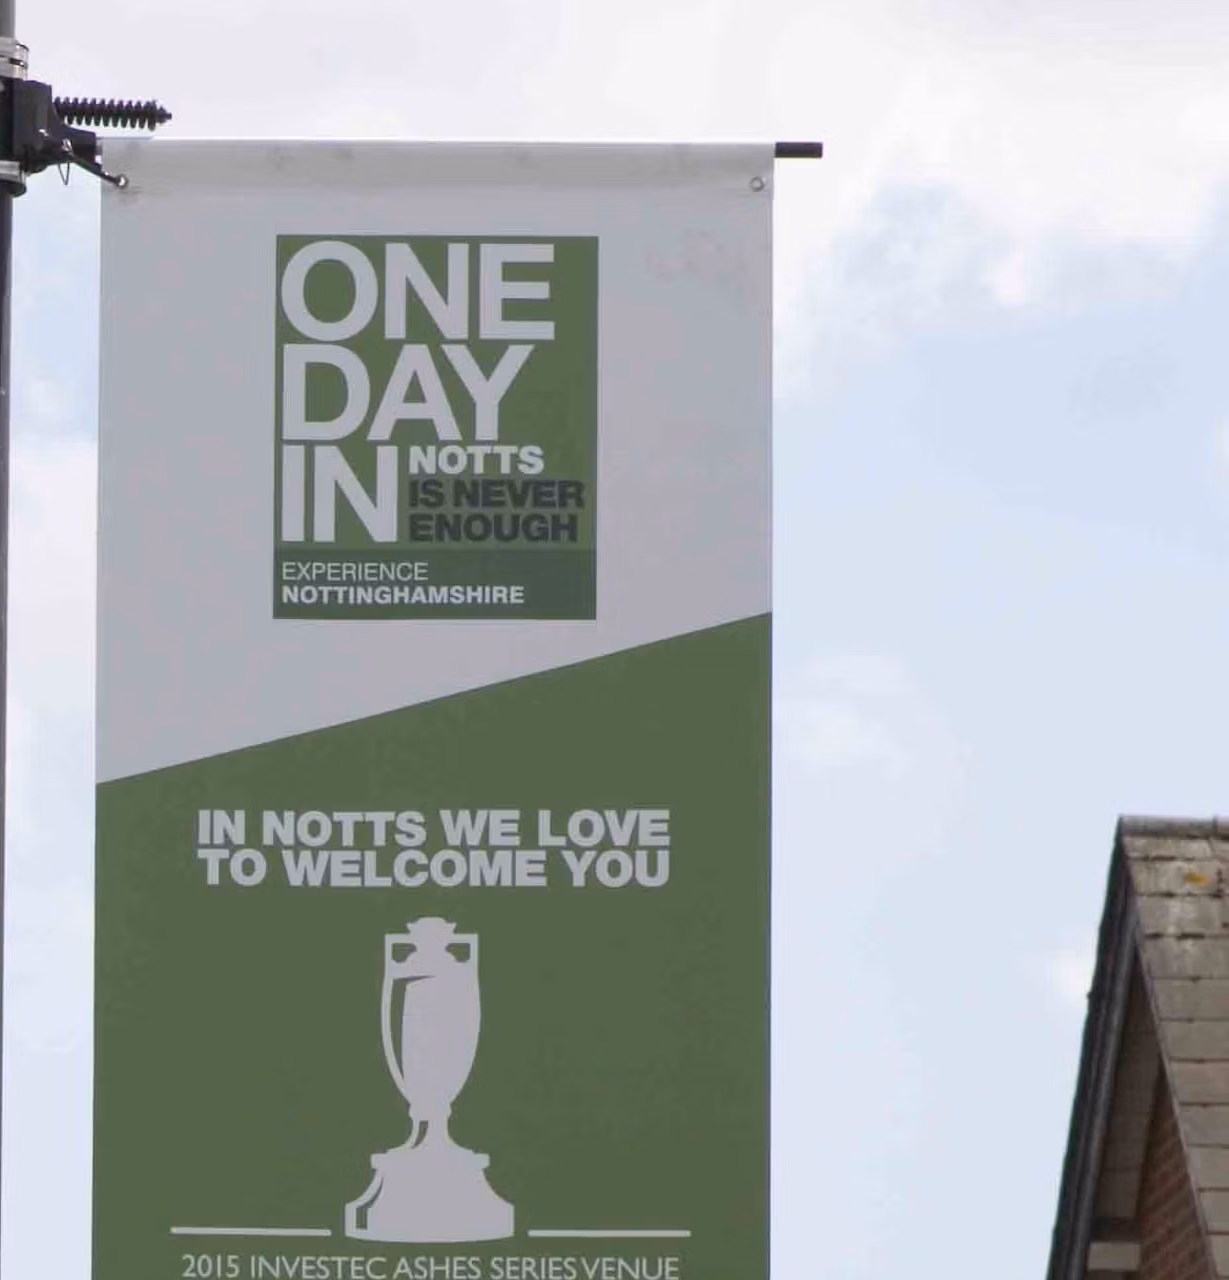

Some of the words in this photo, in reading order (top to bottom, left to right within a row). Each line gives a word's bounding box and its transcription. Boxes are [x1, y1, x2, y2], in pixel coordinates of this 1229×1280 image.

[281, 240, 555, 341] ONE
[282, 344, 535, 440] DAY
[408, 445, 545, 475] NOTTS
[281, 445, 399, 542] IN
[408, 479, 445, 508] IS
[452, 480, 586, 508] NEVER
[408, 514, 578, 543] ENOUGH
[281, 561, 429, 581] EXPERIENCE
[281, 585, 525, 604] NOTTINGHAMSHIRE
[197, 809, 245, 846] IN
[262, 810, 427, 847] NOTTS
[439, 809, 521, 847] WE
[538, 809, 671, 847] LOVE
[197, 849, 267, 886] TO
[282, 850, 548, 887] WELCOME
[564, 850, 670, 888] YOU
[181, 1254, 240, 1279] 2015
[250, 1255, 388, 1280] INVESTEC
[393, 1256, 481, 1280] ASHES
[490, 1256, 580, 1280] SERIES
[581, 1256, 679, 1280] VENUE
